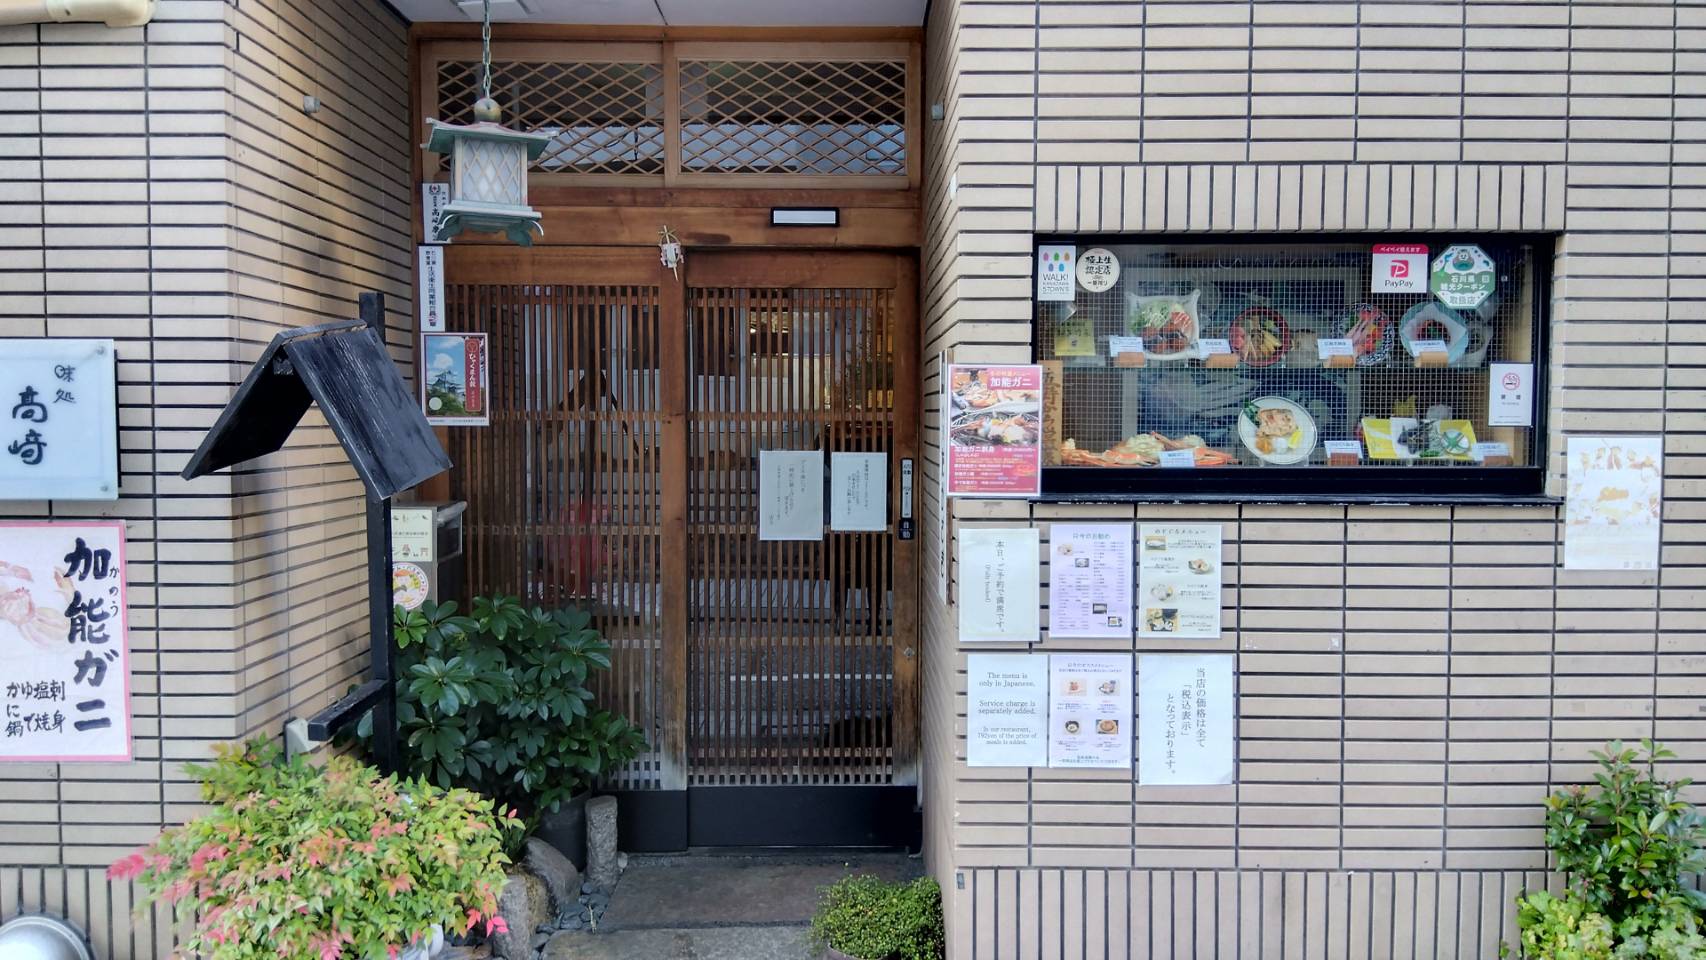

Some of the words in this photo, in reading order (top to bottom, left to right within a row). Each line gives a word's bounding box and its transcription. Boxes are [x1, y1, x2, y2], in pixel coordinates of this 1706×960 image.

[1042, 273, 1069, 281] WALK!
[1085, 255, 1112, 264] 極上生
[1451, 275, 1475, 283] 石川県
[1385, 280, 1413, 288] PayPay
[1440, 283, 1486, 291] 観光クーポン
[54, 365, 76, 404] 味処
[990, 376, 1033, 388] 加能ガニ
[109, 567, 120, 618] かのう
[63, 537, 119, 731] 加能ガニ
[6, 682, 24, 738] かに鍋
[34, 681, 50, 732] 塩焼
[49, 681, 66, 733] 刺身
[1006, 700, 1028, 708] charge
[1181, 685, 1192, 736] 「税込表示」
[1196, 667, 1206, 748] 当店の価格は全て
[1165, 693, 1176, 774] となっております。
